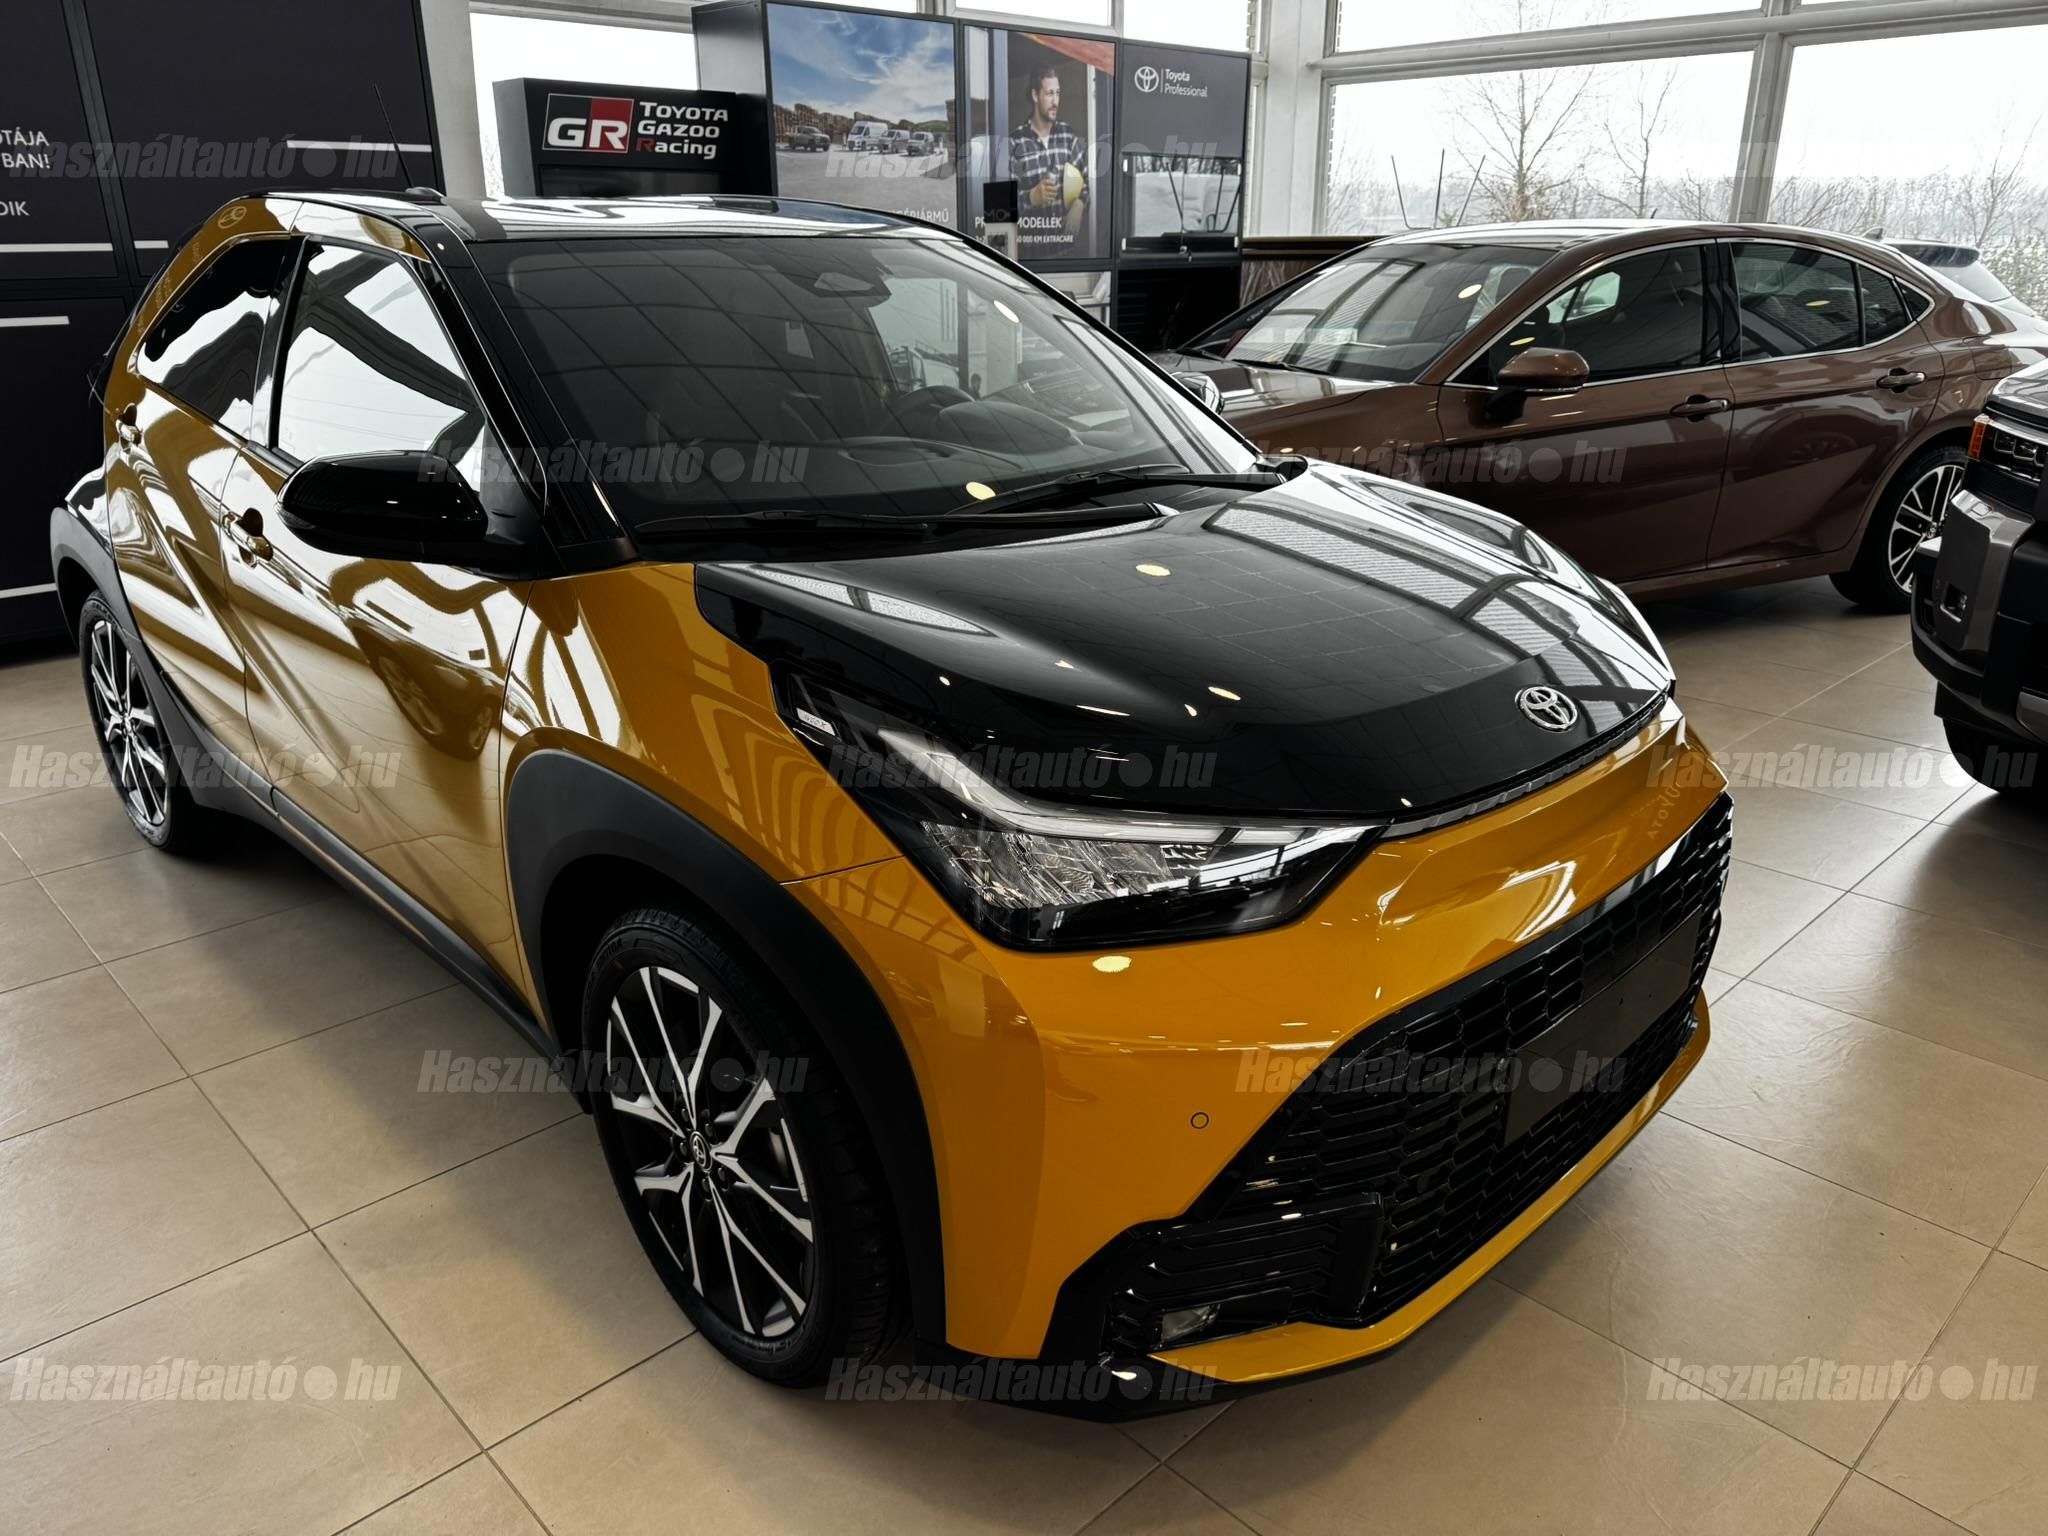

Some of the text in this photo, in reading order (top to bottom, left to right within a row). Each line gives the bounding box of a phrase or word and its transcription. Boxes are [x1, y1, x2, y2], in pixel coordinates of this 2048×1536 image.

[1165, 69, 1190, 82] Toyota
[1165, 83, 1208, 97] Professional
[639, 101, 728, 122] TOYOTA
[0, 126, 50, 146] TÁJA
[547, 117, 628, 150] GR
[637, 120, 720, 138] GAZOO
[636, 138, 717, 160] Racing
[1, 152, 51, 169] BAN!
